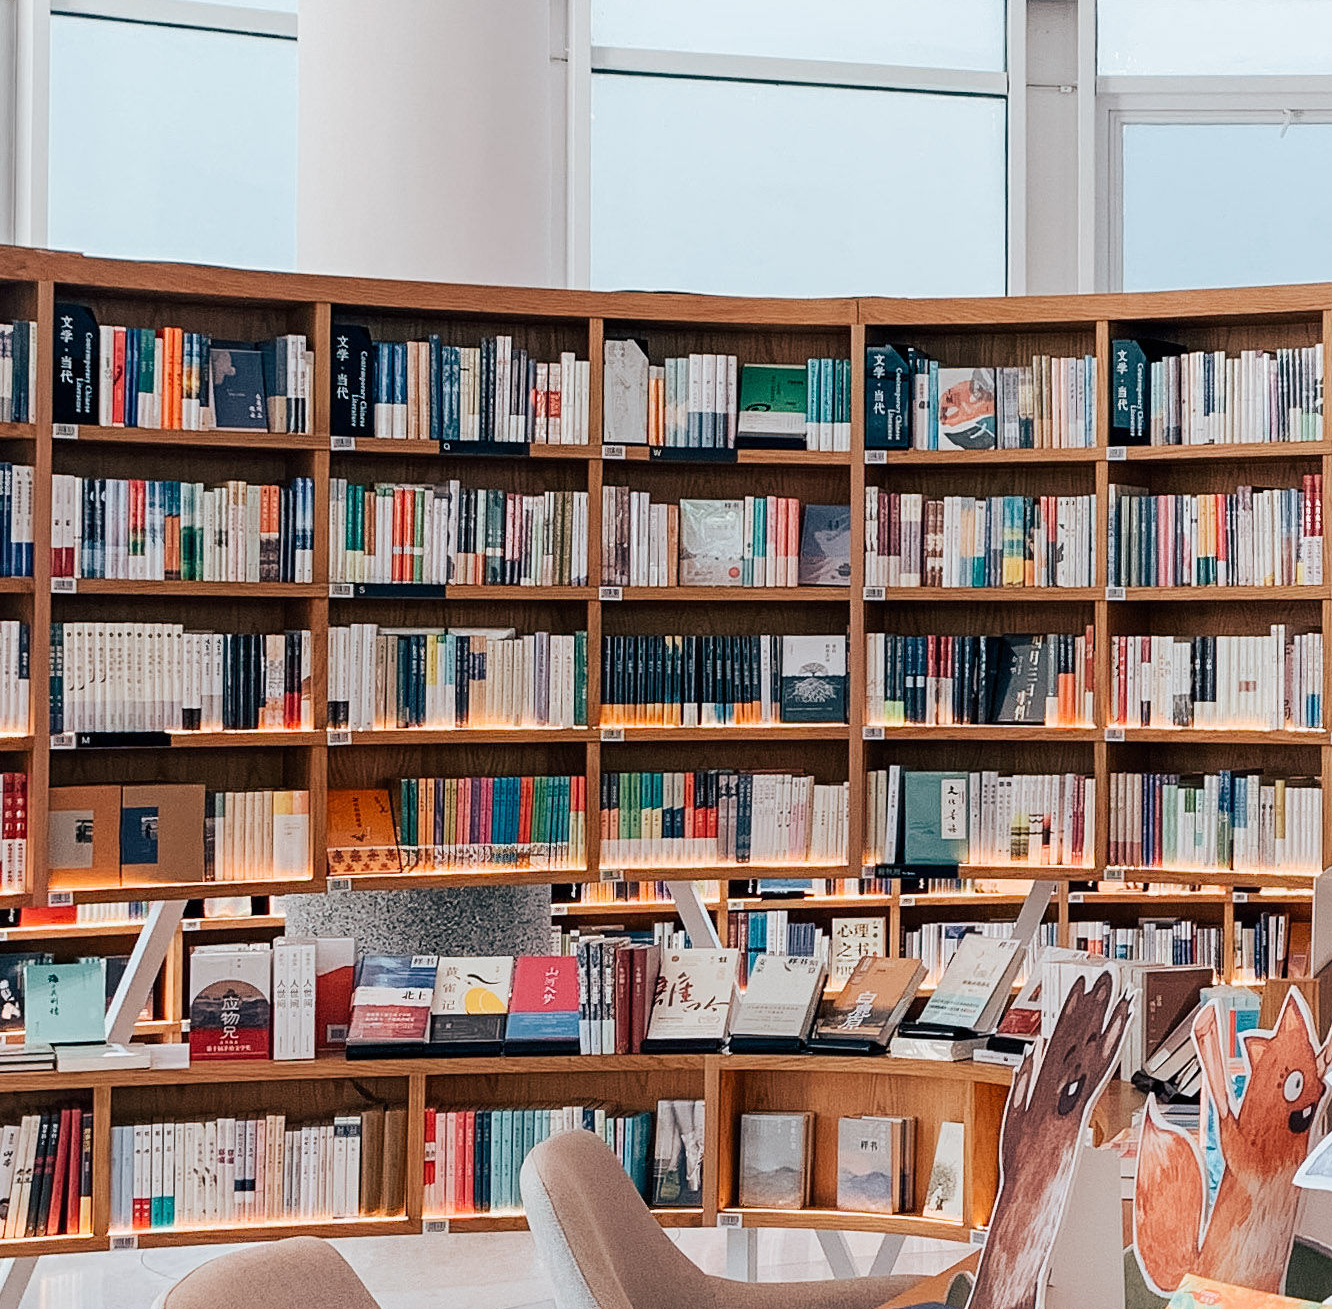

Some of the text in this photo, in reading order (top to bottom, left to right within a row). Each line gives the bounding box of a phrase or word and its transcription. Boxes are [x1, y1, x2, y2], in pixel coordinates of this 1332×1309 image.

[60, 315, 74, 384] 文学·当代
[336, 335, 349, 400] 文学·当代
[81, 736, 91, 745] M
[836, 924, 869, 938] 心理
[836, 942, 869, 958] 之书
[290, 979, 300, 1009] 人世间
[303, 978, 314, 1008] 人世间
[219, 996, 241, 1039] 应物兄
[860, 1140, 878, 1151] 样书
